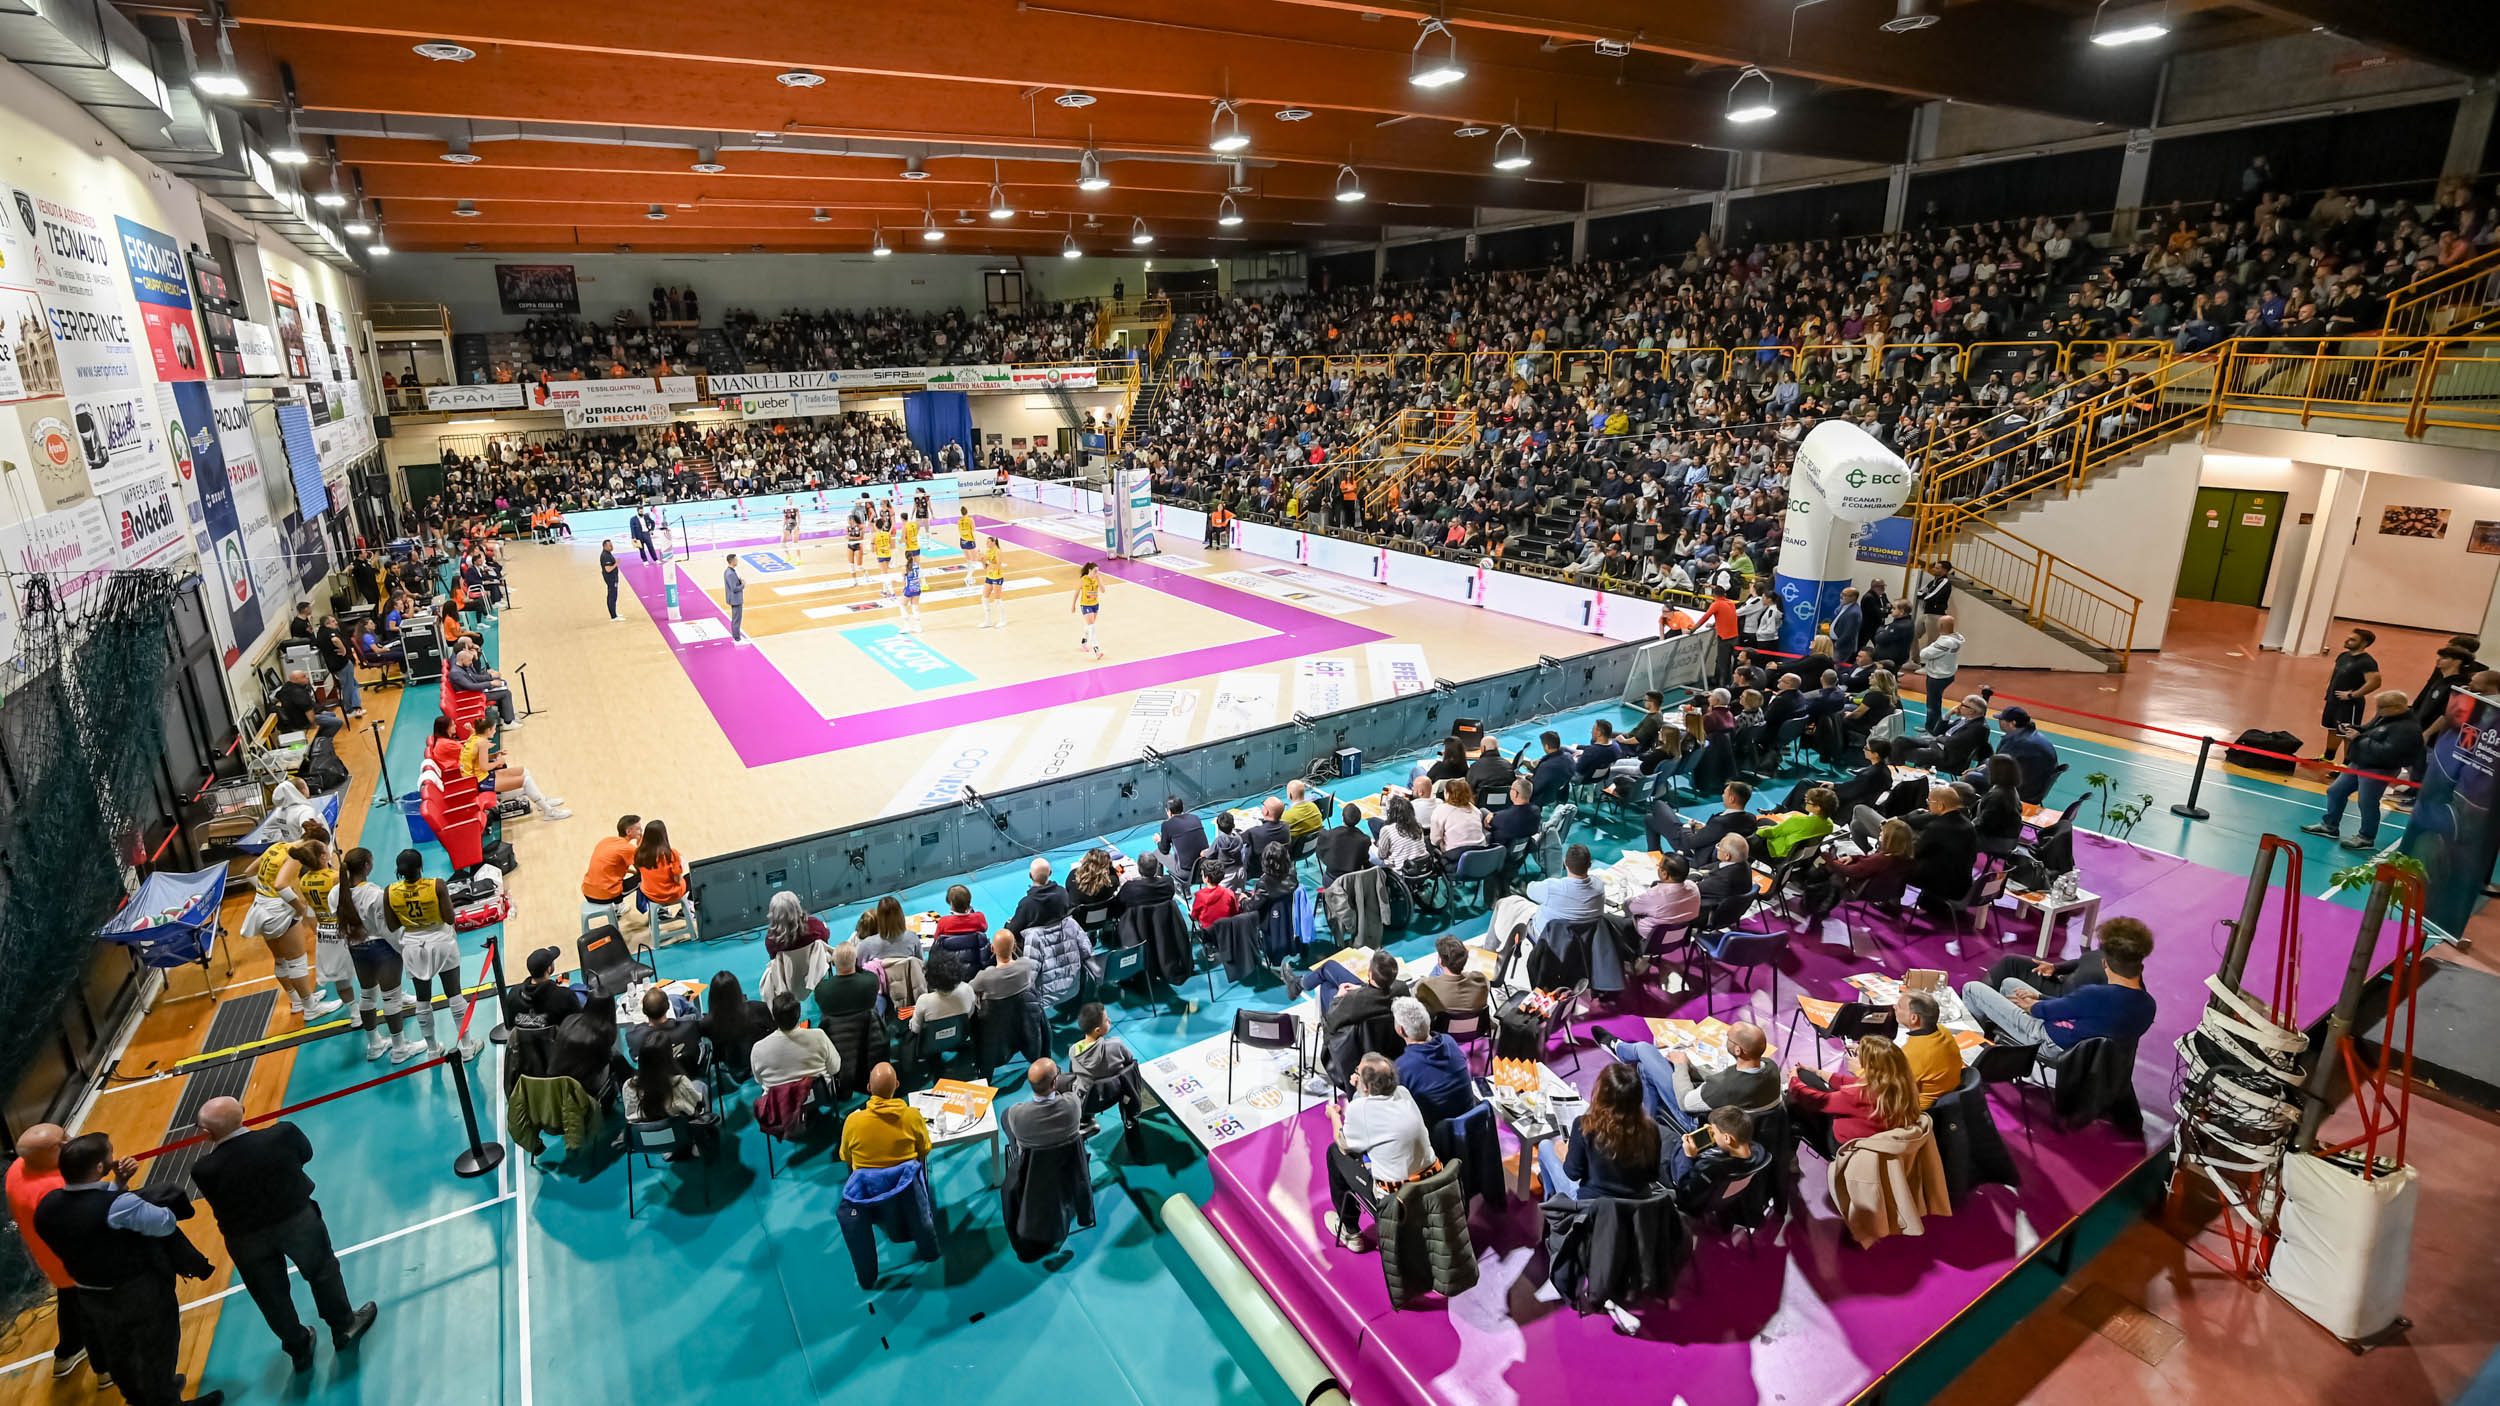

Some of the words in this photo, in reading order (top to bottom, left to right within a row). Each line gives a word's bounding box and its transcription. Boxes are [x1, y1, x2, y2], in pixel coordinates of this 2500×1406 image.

[43, 221, 107, 266] TECNAUTO
[124, 234, 183, 281] FISIOMED
[143, 276, 164, 293] GRUPPO
[48, 307, 130, 343] SERIPRINCE
[587, 384, 641, 393] TESSILQUATTRO
[711, 375, 785, 392] MANUEL
[788, 373, 826, 388] RITZ
[428, 394, 495, 405] FAPAM
[757, 397, 789, 409] ueber
[585, 405, 646, 415] UBRIACHI
[586, 416, 599, 424] DI
[603, 414, 648, 423] HELVIA
[227, 459, 259, 486] PROXIMA
[1872, 474, 1901, 484] BCC
[121, 484, 148, 506] IMPRESA
[149, 476, 166, 494] EDILE
[1869, 546, 1904, 556] FISIOMED
[406, 900, 423, 918] 23
